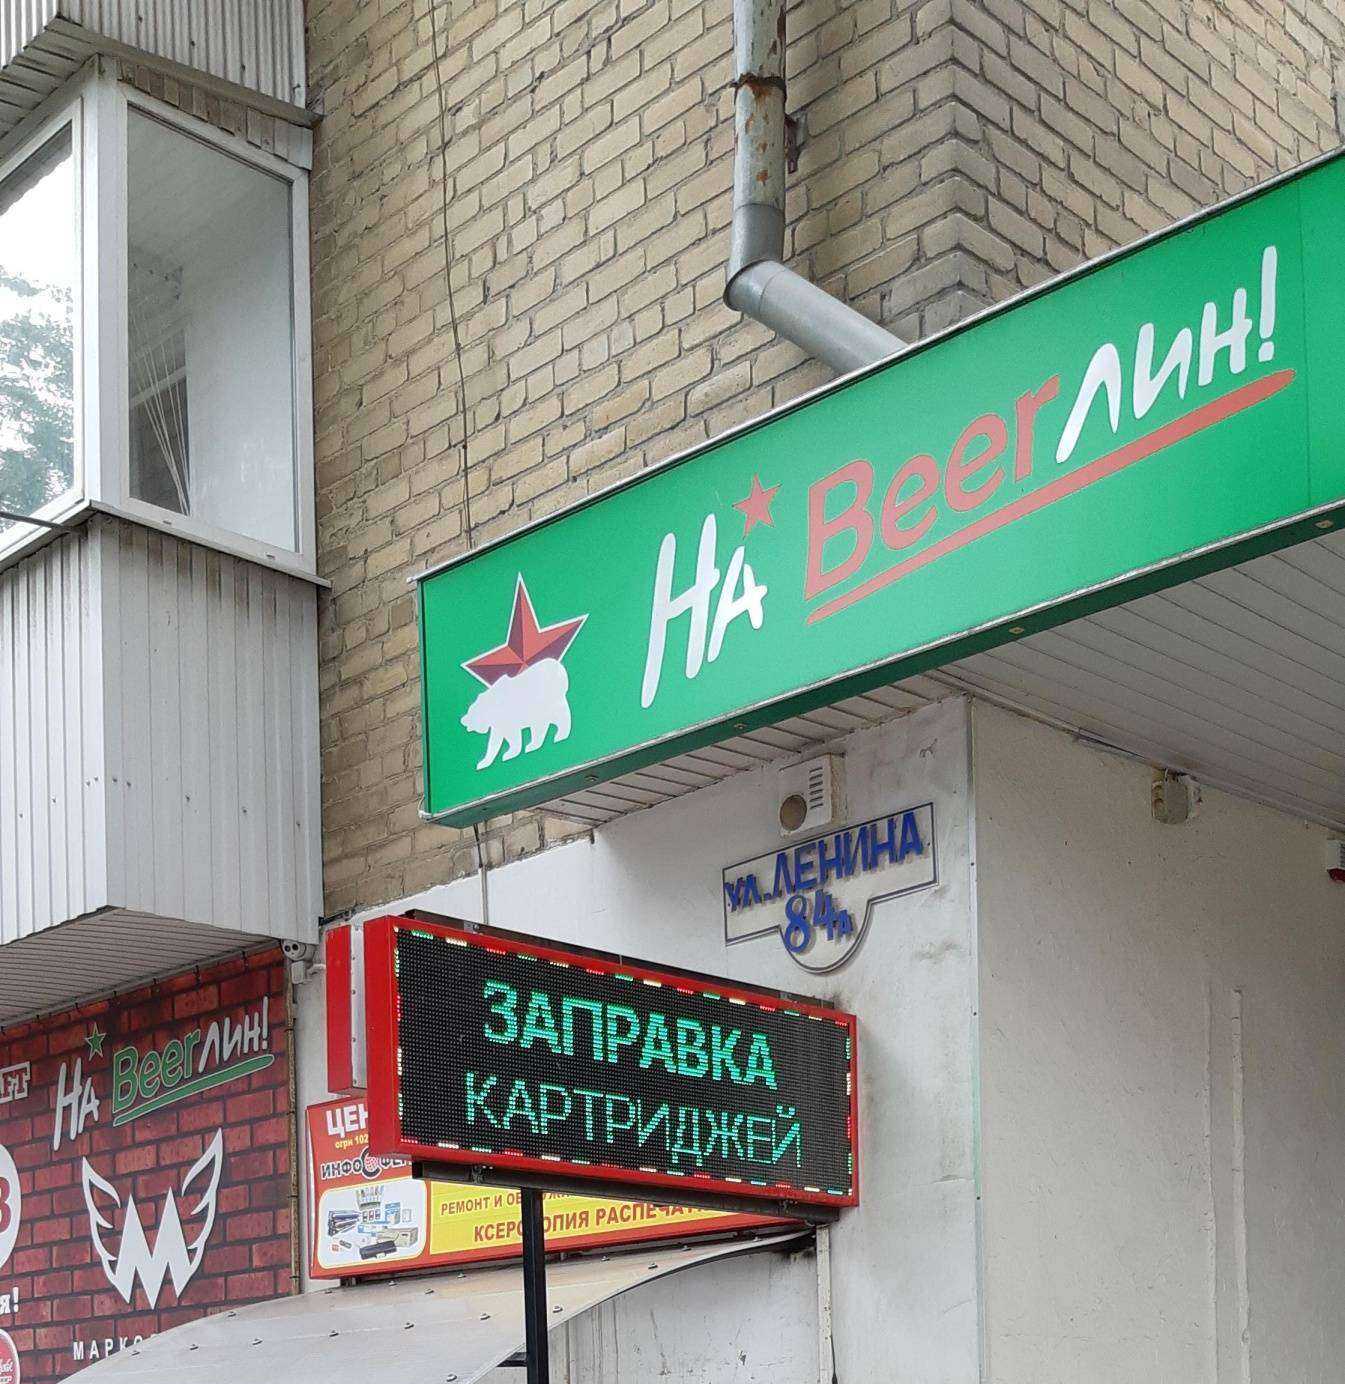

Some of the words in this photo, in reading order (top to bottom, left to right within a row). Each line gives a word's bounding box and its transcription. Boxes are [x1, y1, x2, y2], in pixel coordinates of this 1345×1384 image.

[483, 979, 778, 1091] ЗАПРАВКА
[326, 1103, 369, 1138] ЦЕН
[465, 1071, 802, 1168] КАРТРИДЖЕЙ
[355, 1134, 369, 1145] 102
[441, 1197, 490, 1216] РЕМОНТ
[494, 1196, 502, 1208] И
[474, 1210, 589, 1243] КСЕРООПИЯ
